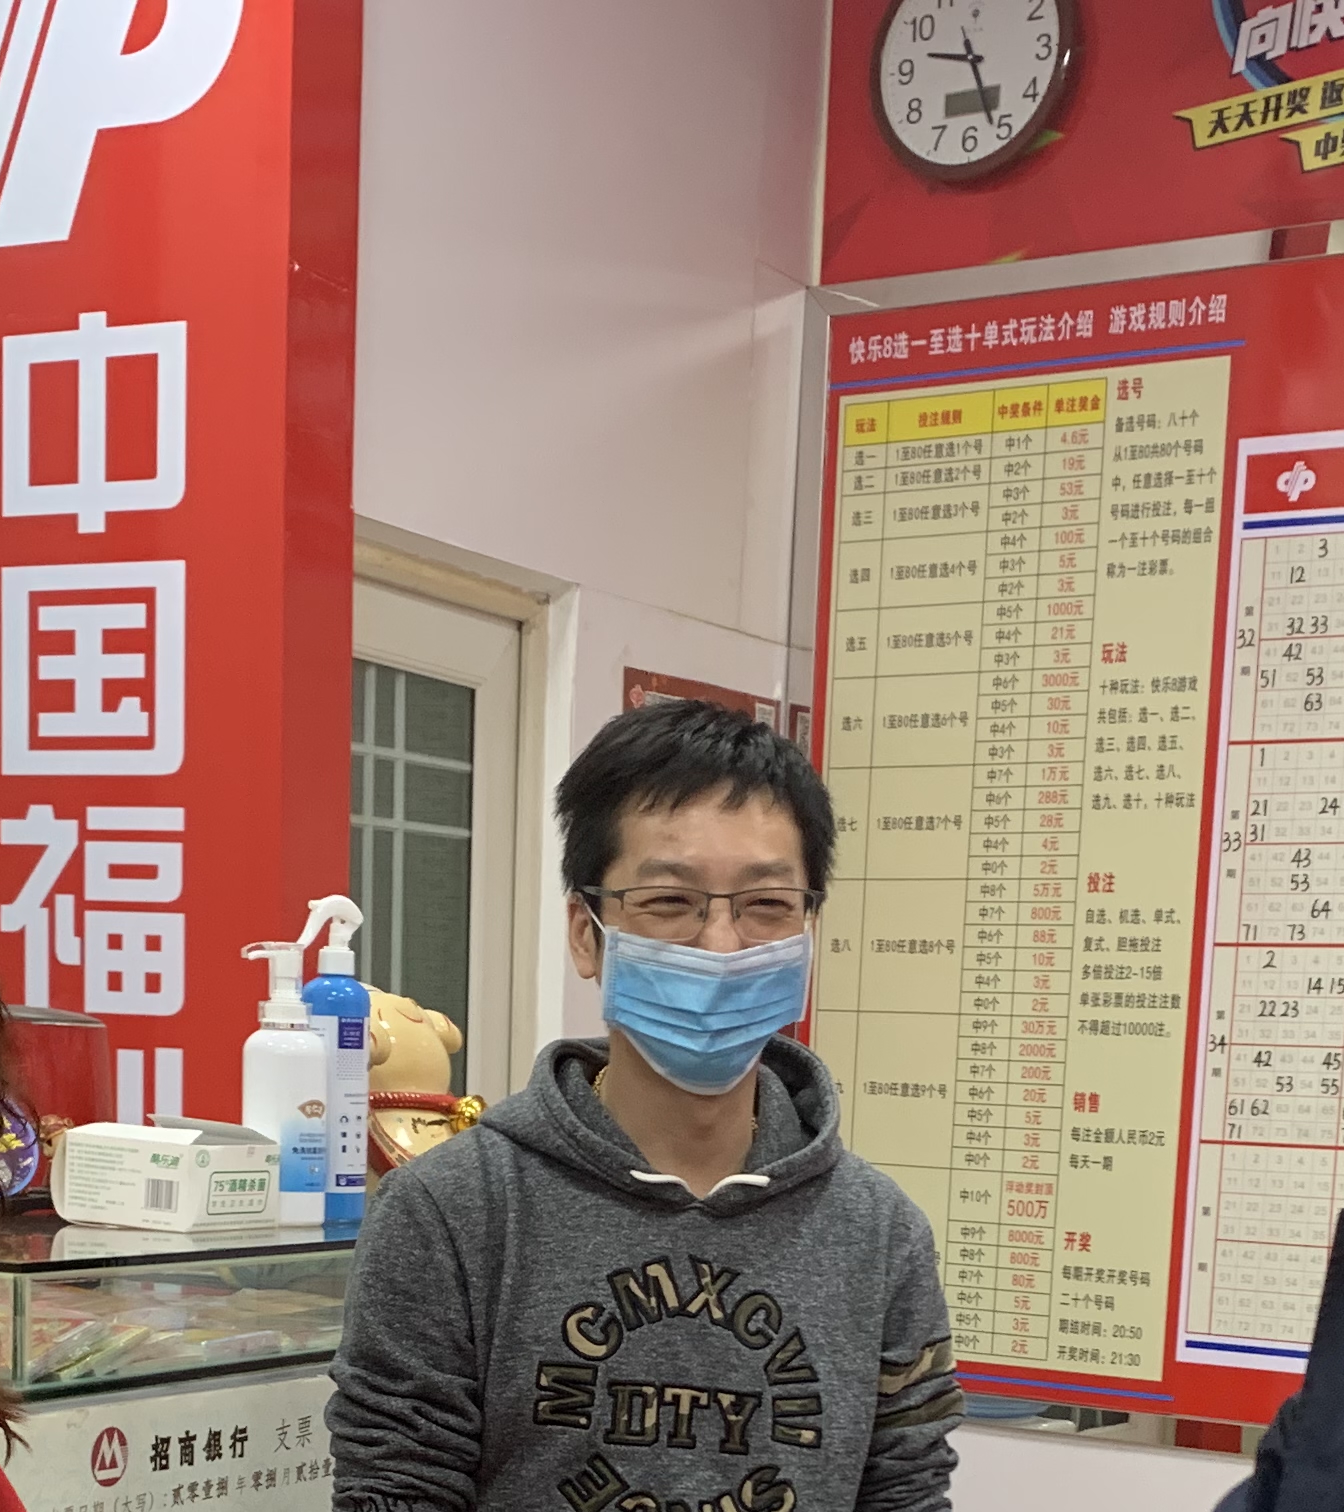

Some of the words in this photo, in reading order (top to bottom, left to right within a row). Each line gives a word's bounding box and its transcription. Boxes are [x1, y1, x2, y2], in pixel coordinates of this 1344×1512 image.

[909, 14, 935, 43] 10
[1035, 33, 1052, 61] 3
[898, 58, 914, 85] 9
[1022, 76, 1039, 102] 4
[906, 97, 922, 124] 8
[1207, 86, 1311, 139] 天天开奖
[931, 124, 948, 151] 7
[996, 113, 1012, 140] 5
[961, 126, 978, 153] 6
[848, 310, 1096, 365] 快乐8选一至选十单式玩法介绍
[1108, 293, 1228, 336] 游戏规则介绍
[1116, 378, 1144, 400] 选号
[1317, 537, 1329, 558] 3
[1289, 564, 1308, 585] 12
[1286, 615, 1306, 636] 32
[1309, 613, 1329, 634] 33
[1236, 628, 1256, 650] 32
[1101, 643, 1128, 664] 玩法
[1222, 831, 1242, 853] 33
[1087, 872, 1116, 894] 投注
[1208, 1034, 1228, 1054] 34
[1072, 1091, 1101, 1115] 销售
[1228, 1099, 1245, 1117] 61
[1250, 1098, 1270, 1116] 62
[1006, 1199, 1049, 1220] 500万
[1063, 1231, 1092, 1253] 开奖
[532, 1254, 823, 1450] MCMXCVII
[602, 1380, 764, 1456] DTY
[149, 1424, 250, 1472] 招商银行
[273, 1414, 313, 1453] 支票
